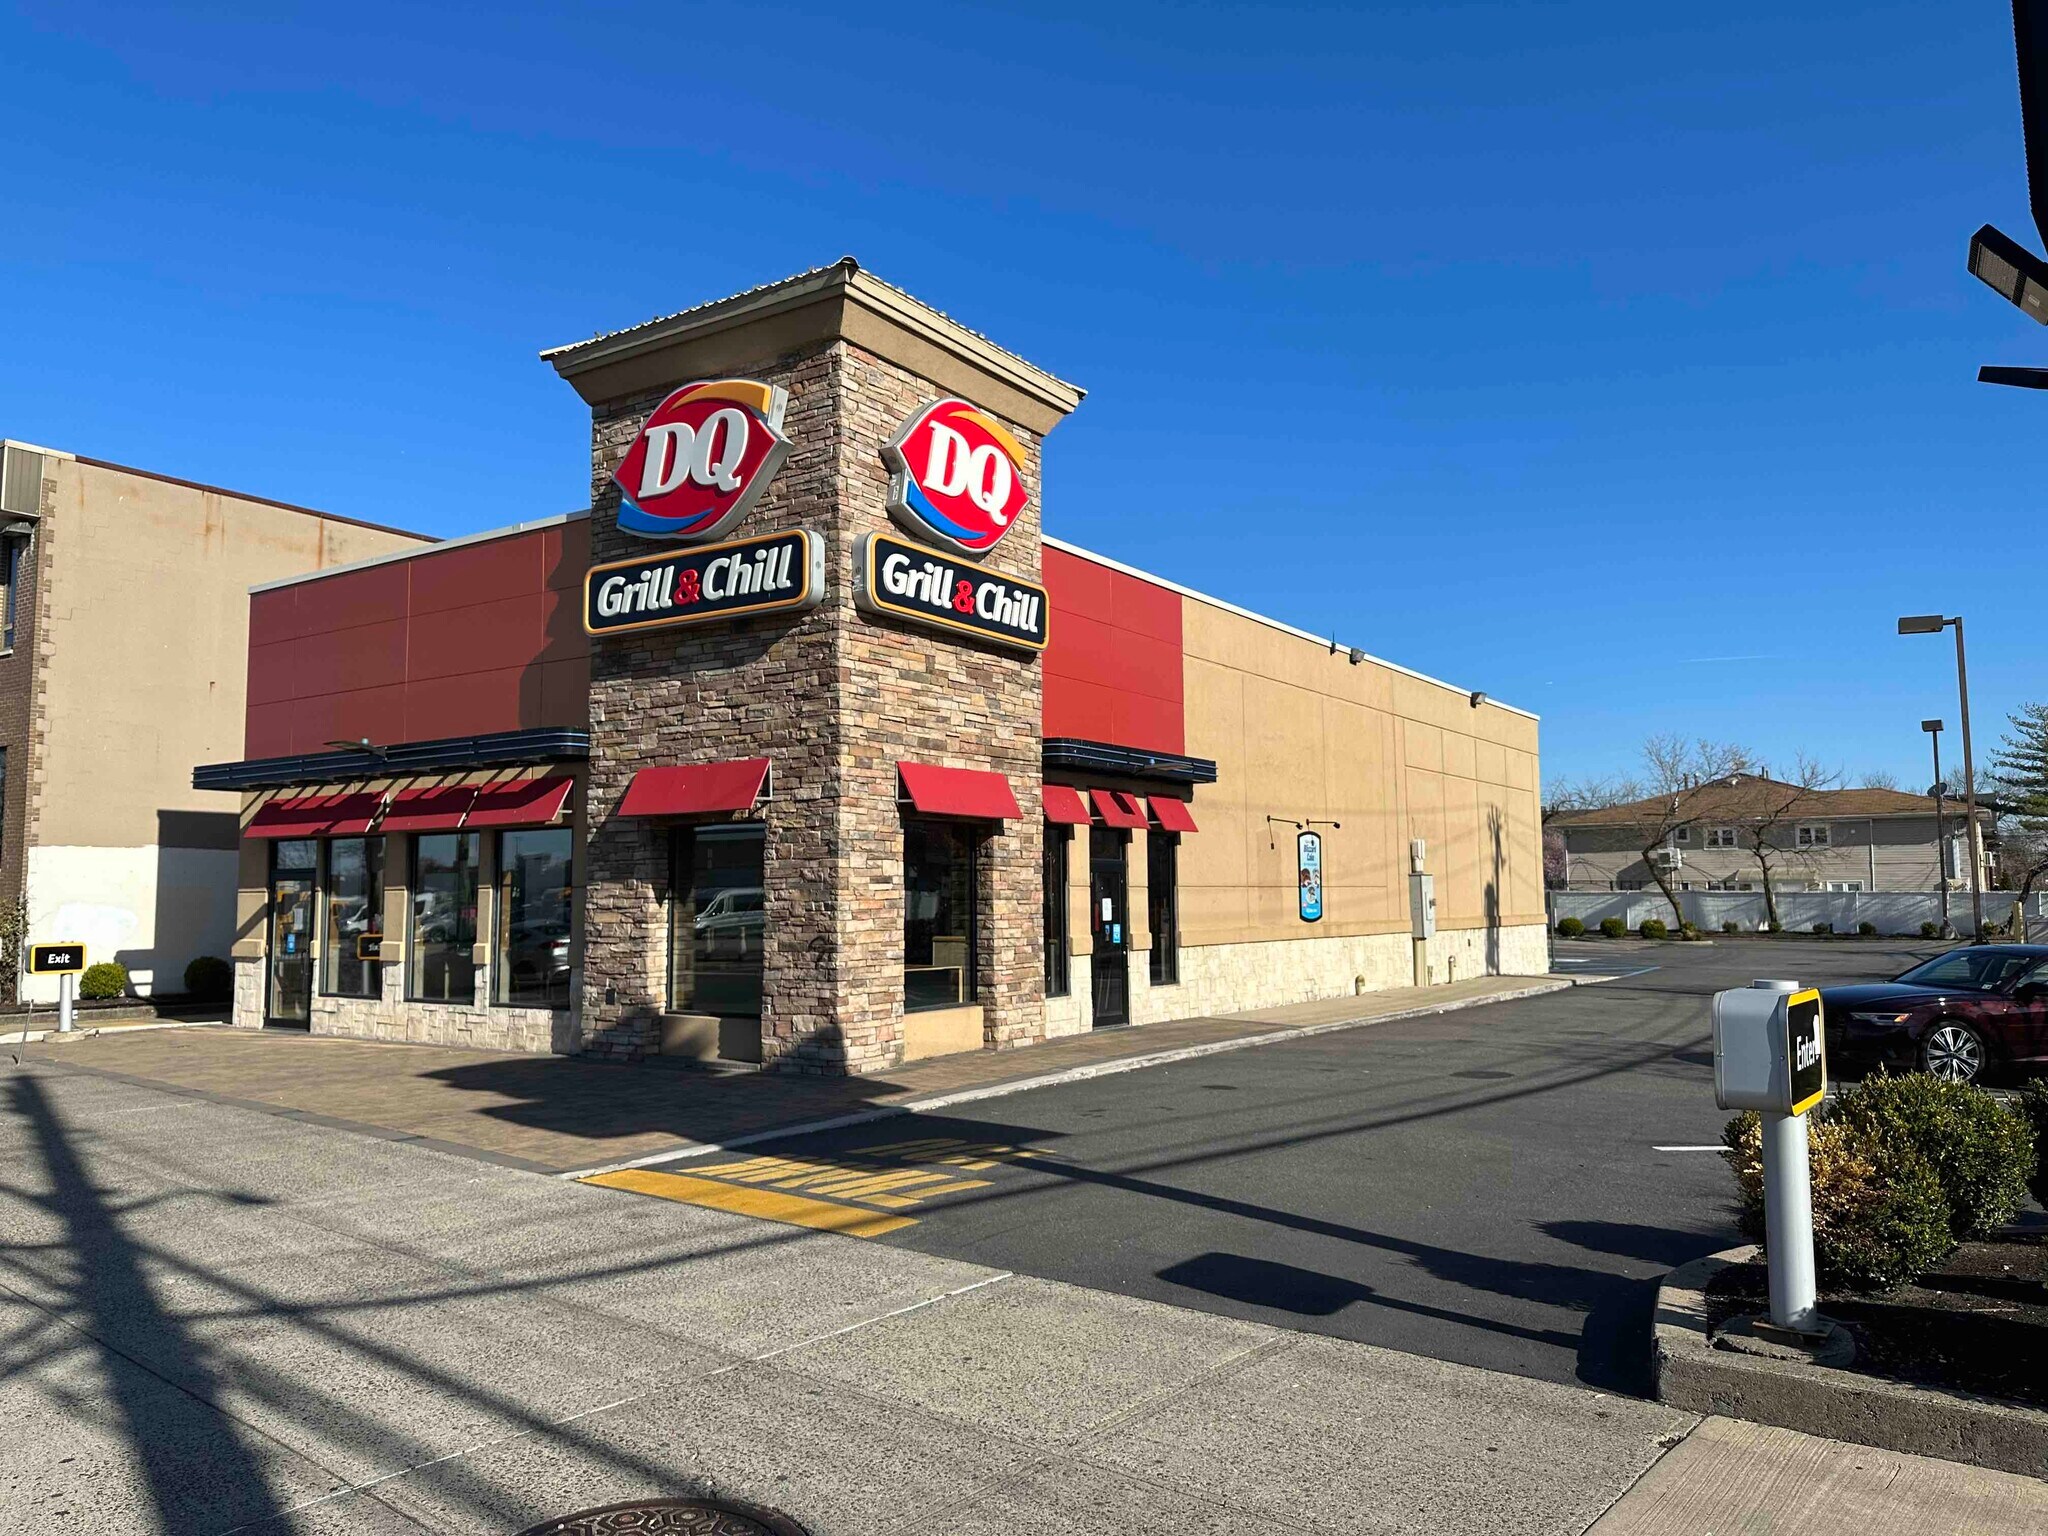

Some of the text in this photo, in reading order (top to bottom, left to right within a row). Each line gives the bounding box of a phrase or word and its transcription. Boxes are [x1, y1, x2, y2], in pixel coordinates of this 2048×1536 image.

[637, 408, 749, 499] DQ
[922, 419, 1012, 527] DQ
[47, 953, 71, 964] Exit
[1796, 1036, 1816, 1071] Enter
